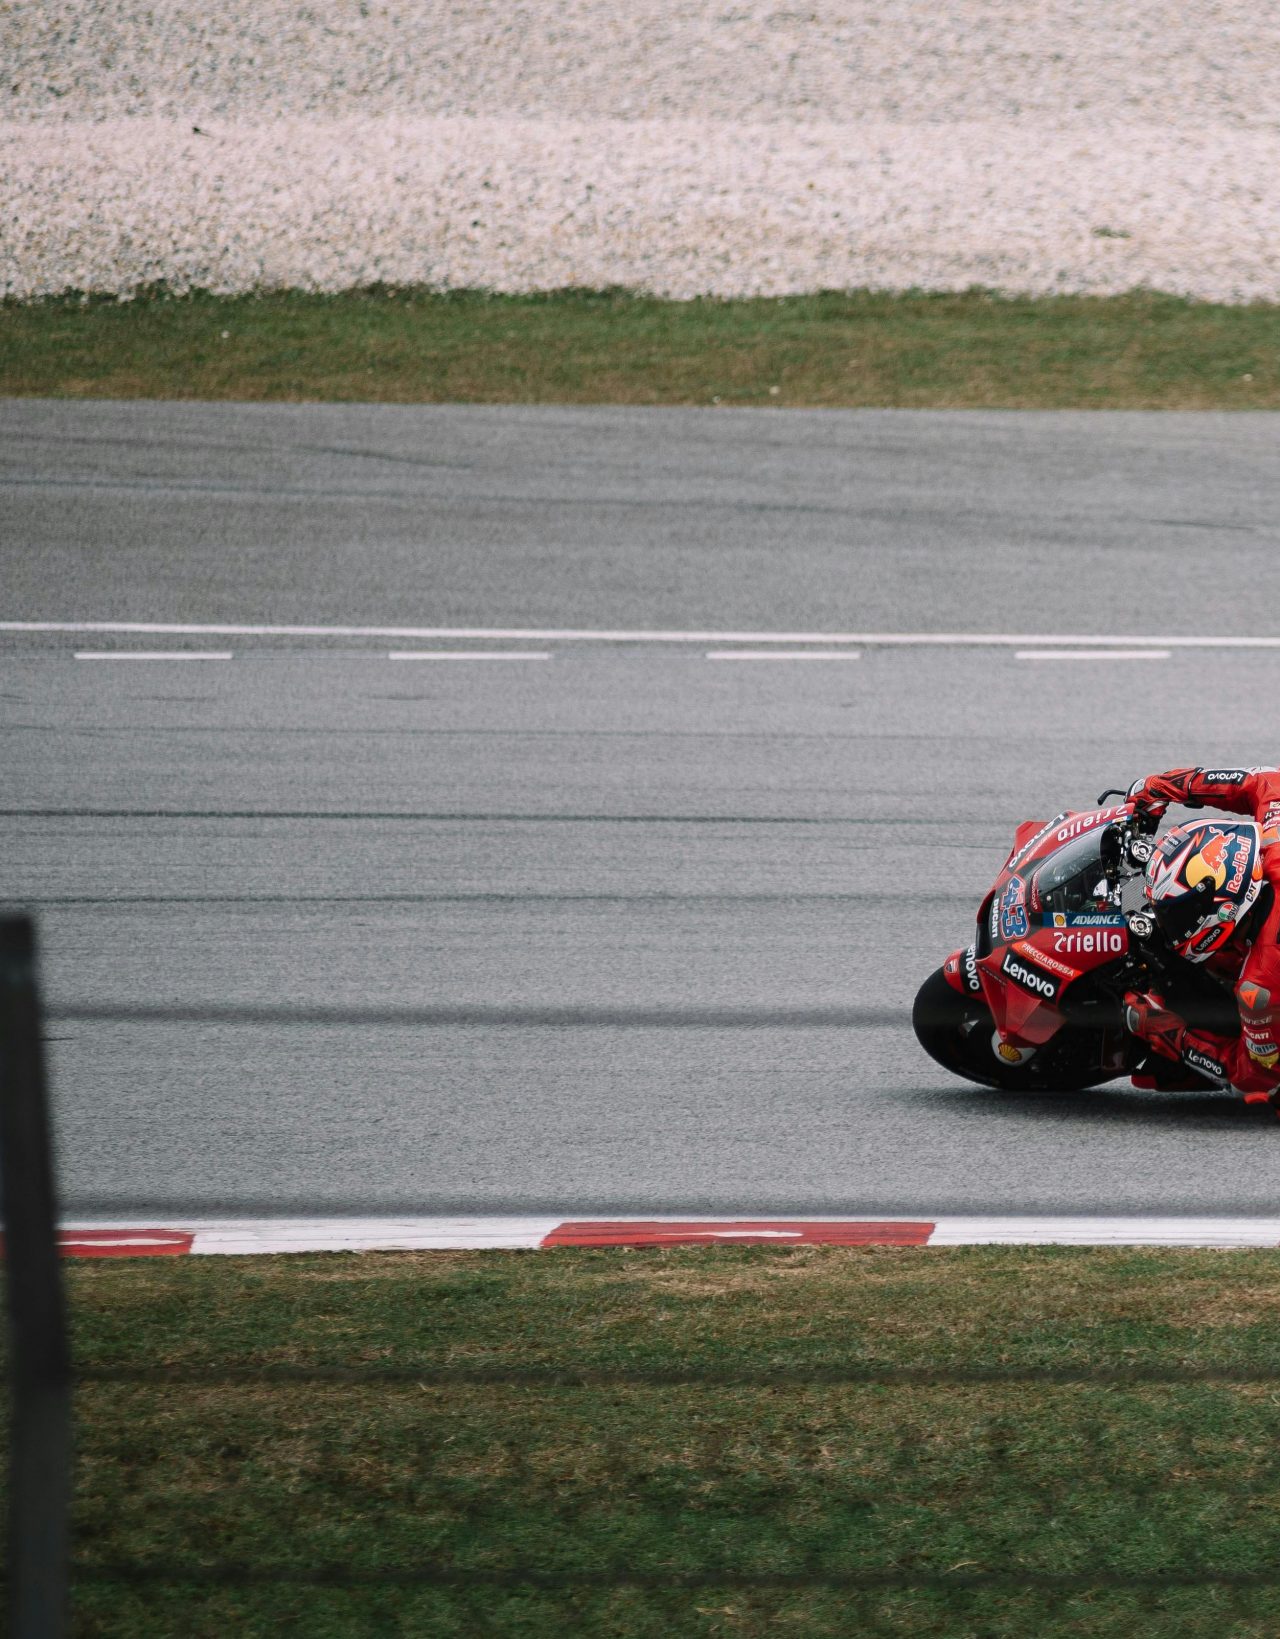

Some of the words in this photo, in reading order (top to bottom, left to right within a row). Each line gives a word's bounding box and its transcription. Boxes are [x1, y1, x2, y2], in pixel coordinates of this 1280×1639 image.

[992, 898, 1000, 939] DUCATI
[1072, 915, 1121, 925] ADVANCE
[1065, 931, 1122, 952] riello
[1196, 928, 1221, 951] Lenovo
[965, 943, 980, 990] enovo
[1021, 943, 1075, 977] FRECCIAROSSA
[1002, 954, 1055, 998] Lenovo
[1188, 1049, 1222, 1075] Lenovo
